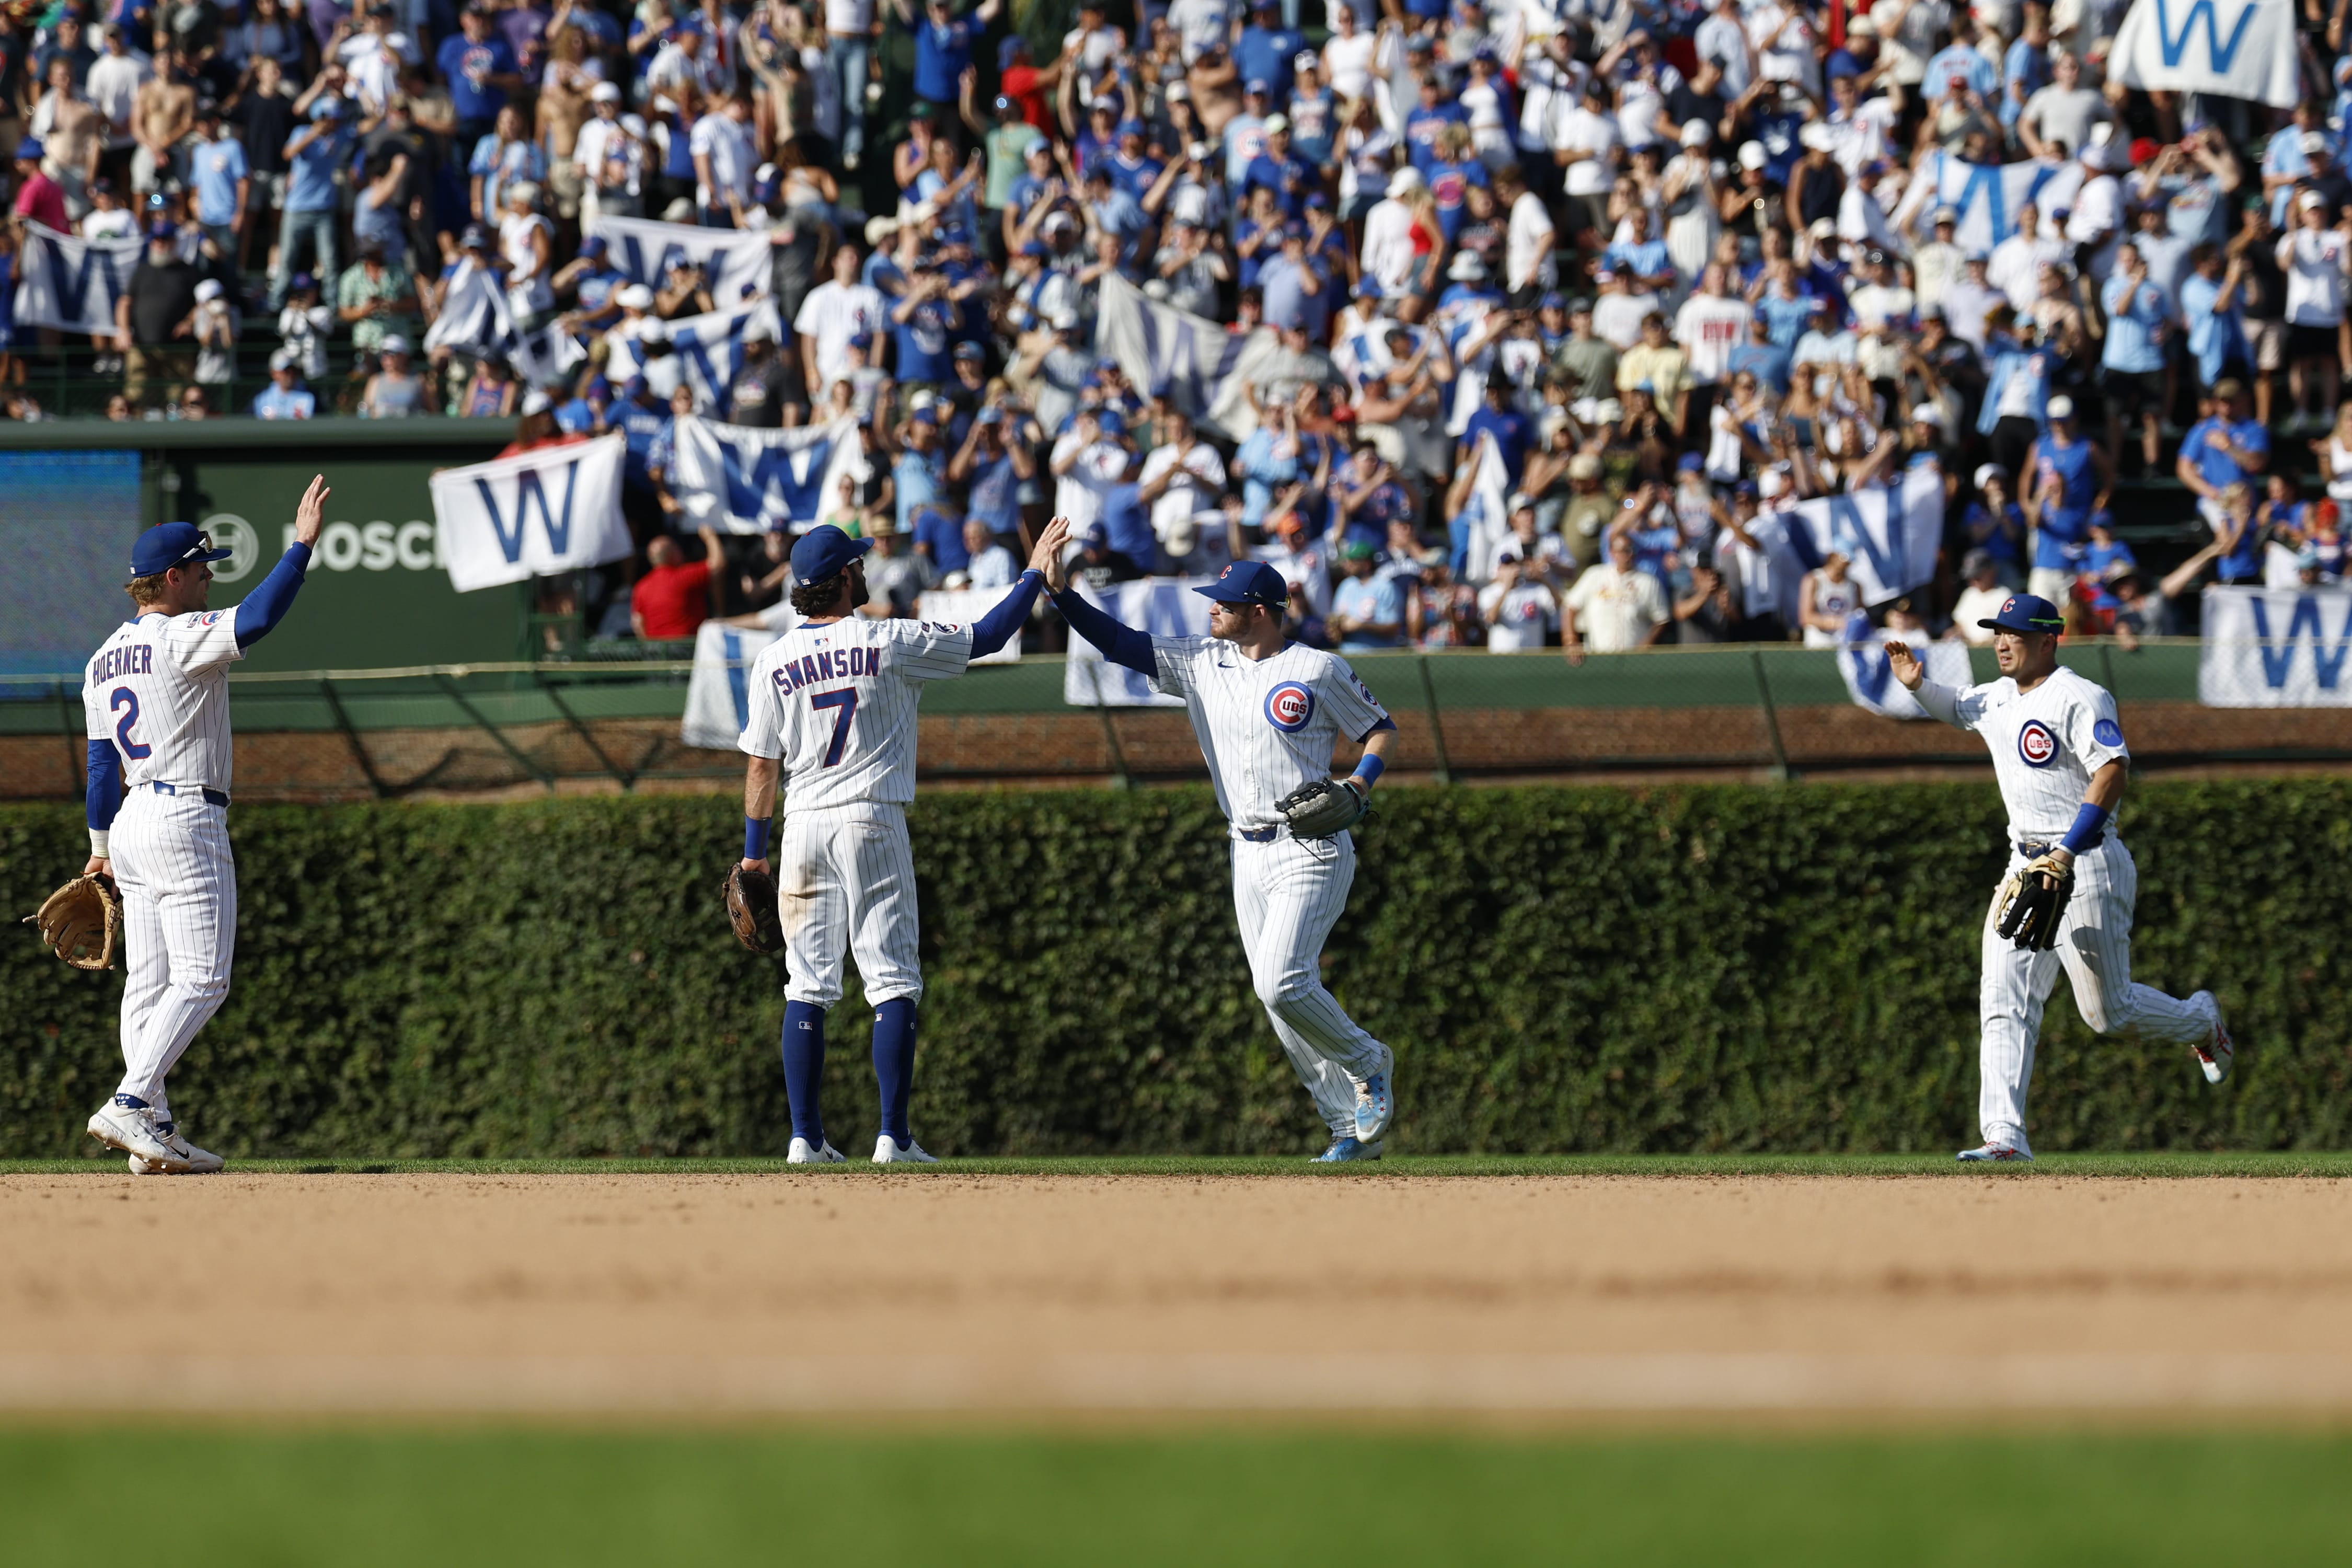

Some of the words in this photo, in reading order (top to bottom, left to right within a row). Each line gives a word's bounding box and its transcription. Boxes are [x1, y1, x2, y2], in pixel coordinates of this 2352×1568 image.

[2157, 0, 2257, 74] W
[1138, 299, 1246, 418] W
[475, 459, 579, 563] W
[718, 439, 830, 521] W
[282, 521, 446, 571] OSC
[2002, 598, 2015, 613] C
[2250, 596, 2352, 688] W
[93, 644, 152, 688] HOERNER
[772, 647, 881, 696] SWANSON
[110, 686, 152, 760] 2
[811, 686, 858, 768] 7
[1273, 689, 1307, 724] CUBS
[2024, 728, 2051, 759] CUBS
